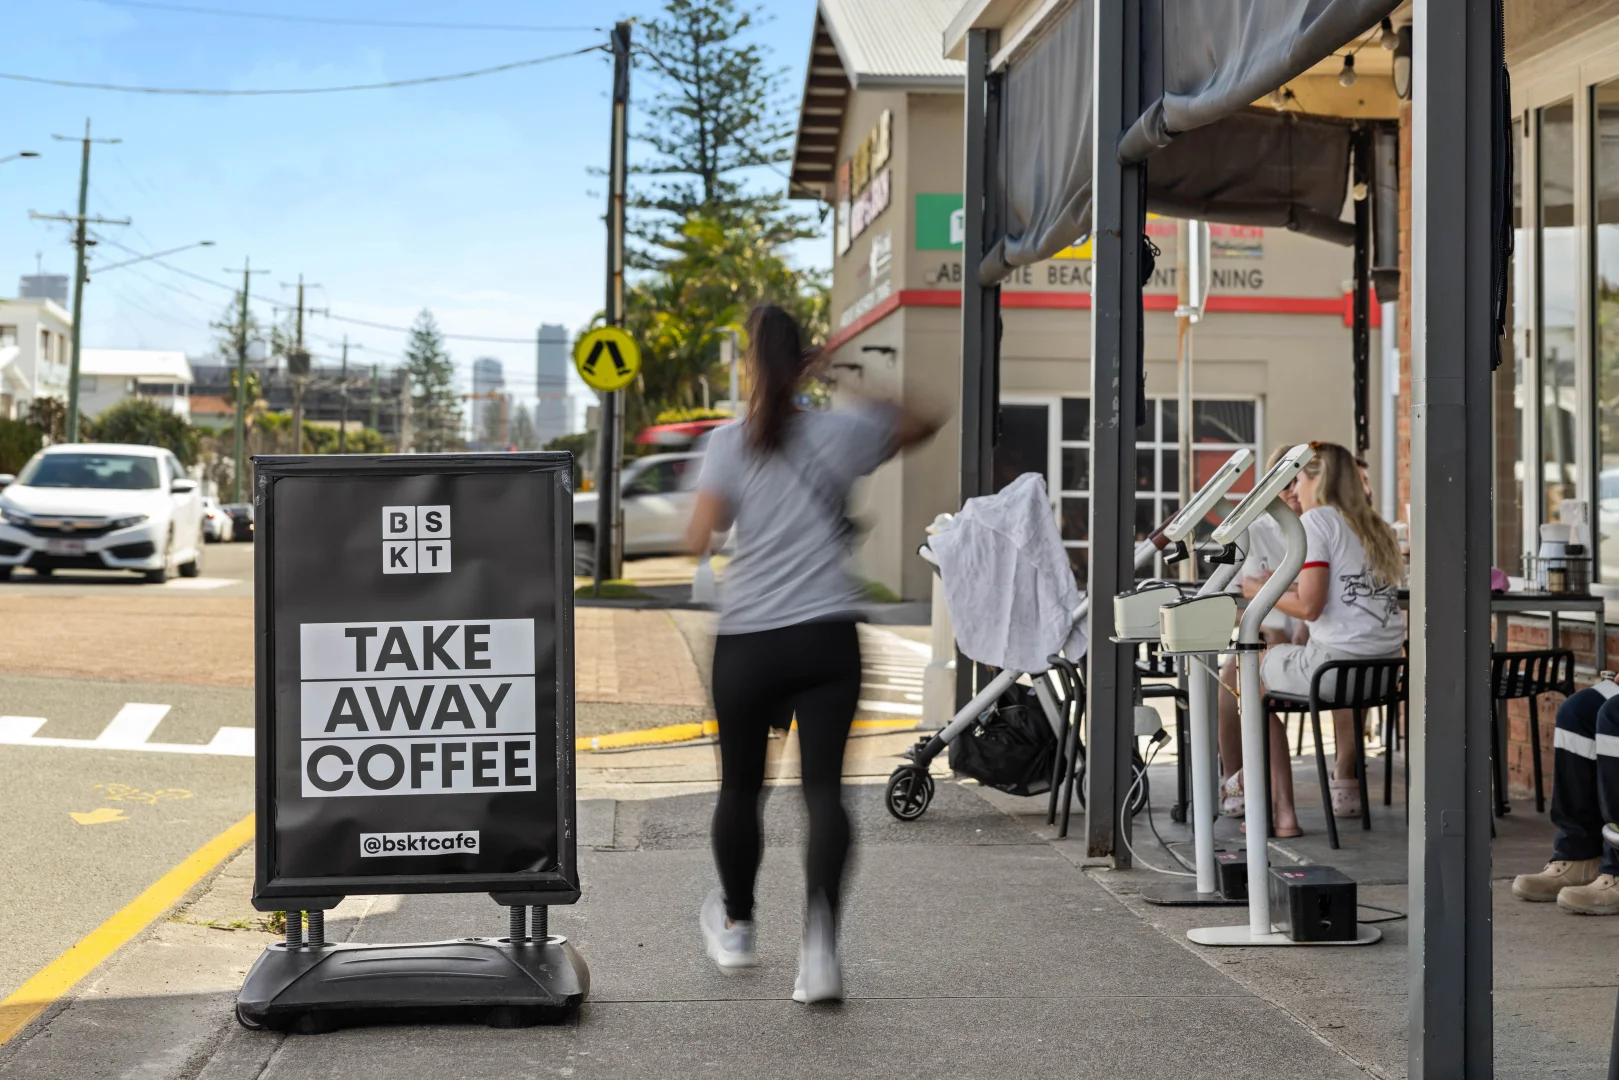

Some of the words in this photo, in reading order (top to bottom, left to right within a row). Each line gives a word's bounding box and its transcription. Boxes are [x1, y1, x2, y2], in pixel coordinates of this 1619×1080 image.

[1212, 267, 1264, 289] NING
[344, 624, 492, 673] TAKE
[323, 682, 513, 733] AWAY
[306, 740, 532, 792] COFFEE
[363, 834, 478, 855] @bsktcafe
